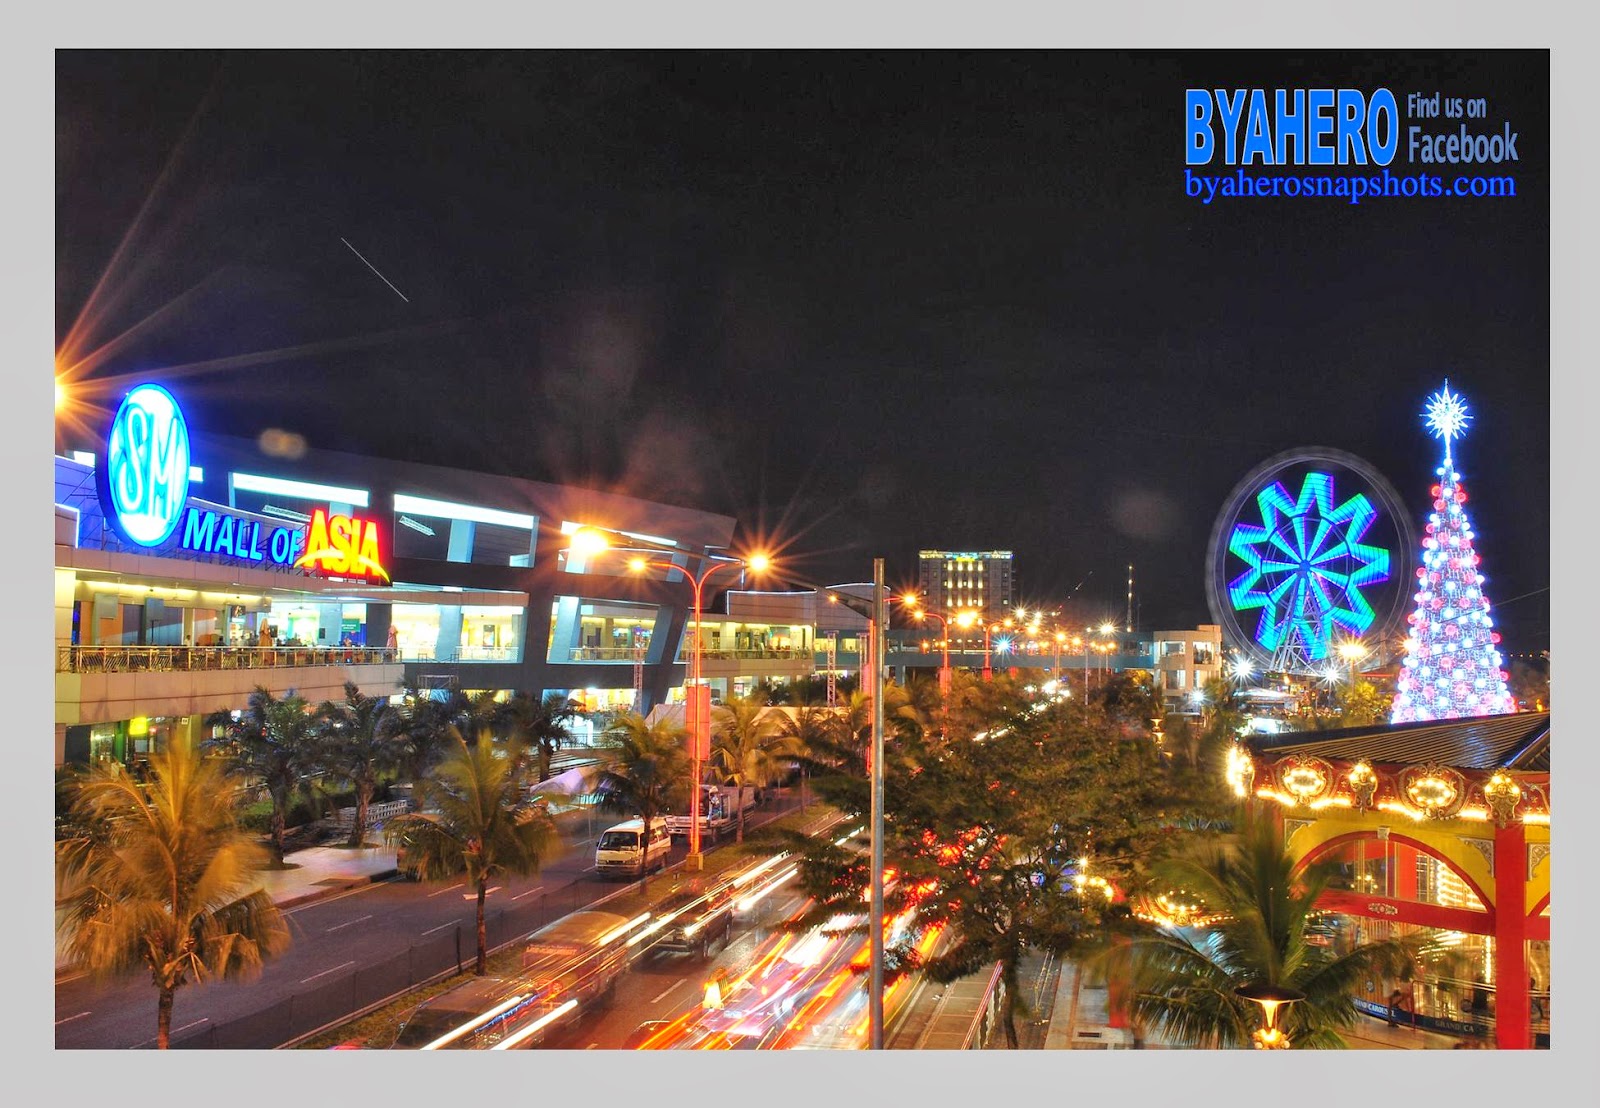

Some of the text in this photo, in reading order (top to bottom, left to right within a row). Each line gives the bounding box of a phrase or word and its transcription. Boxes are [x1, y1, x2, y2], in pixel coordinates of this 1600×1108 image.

[113, 400, 183, 523] SM
[181, 507, 383, 578] MALL OF ASIA
[1367, 1003, 1397, 1018] CAROUSL
